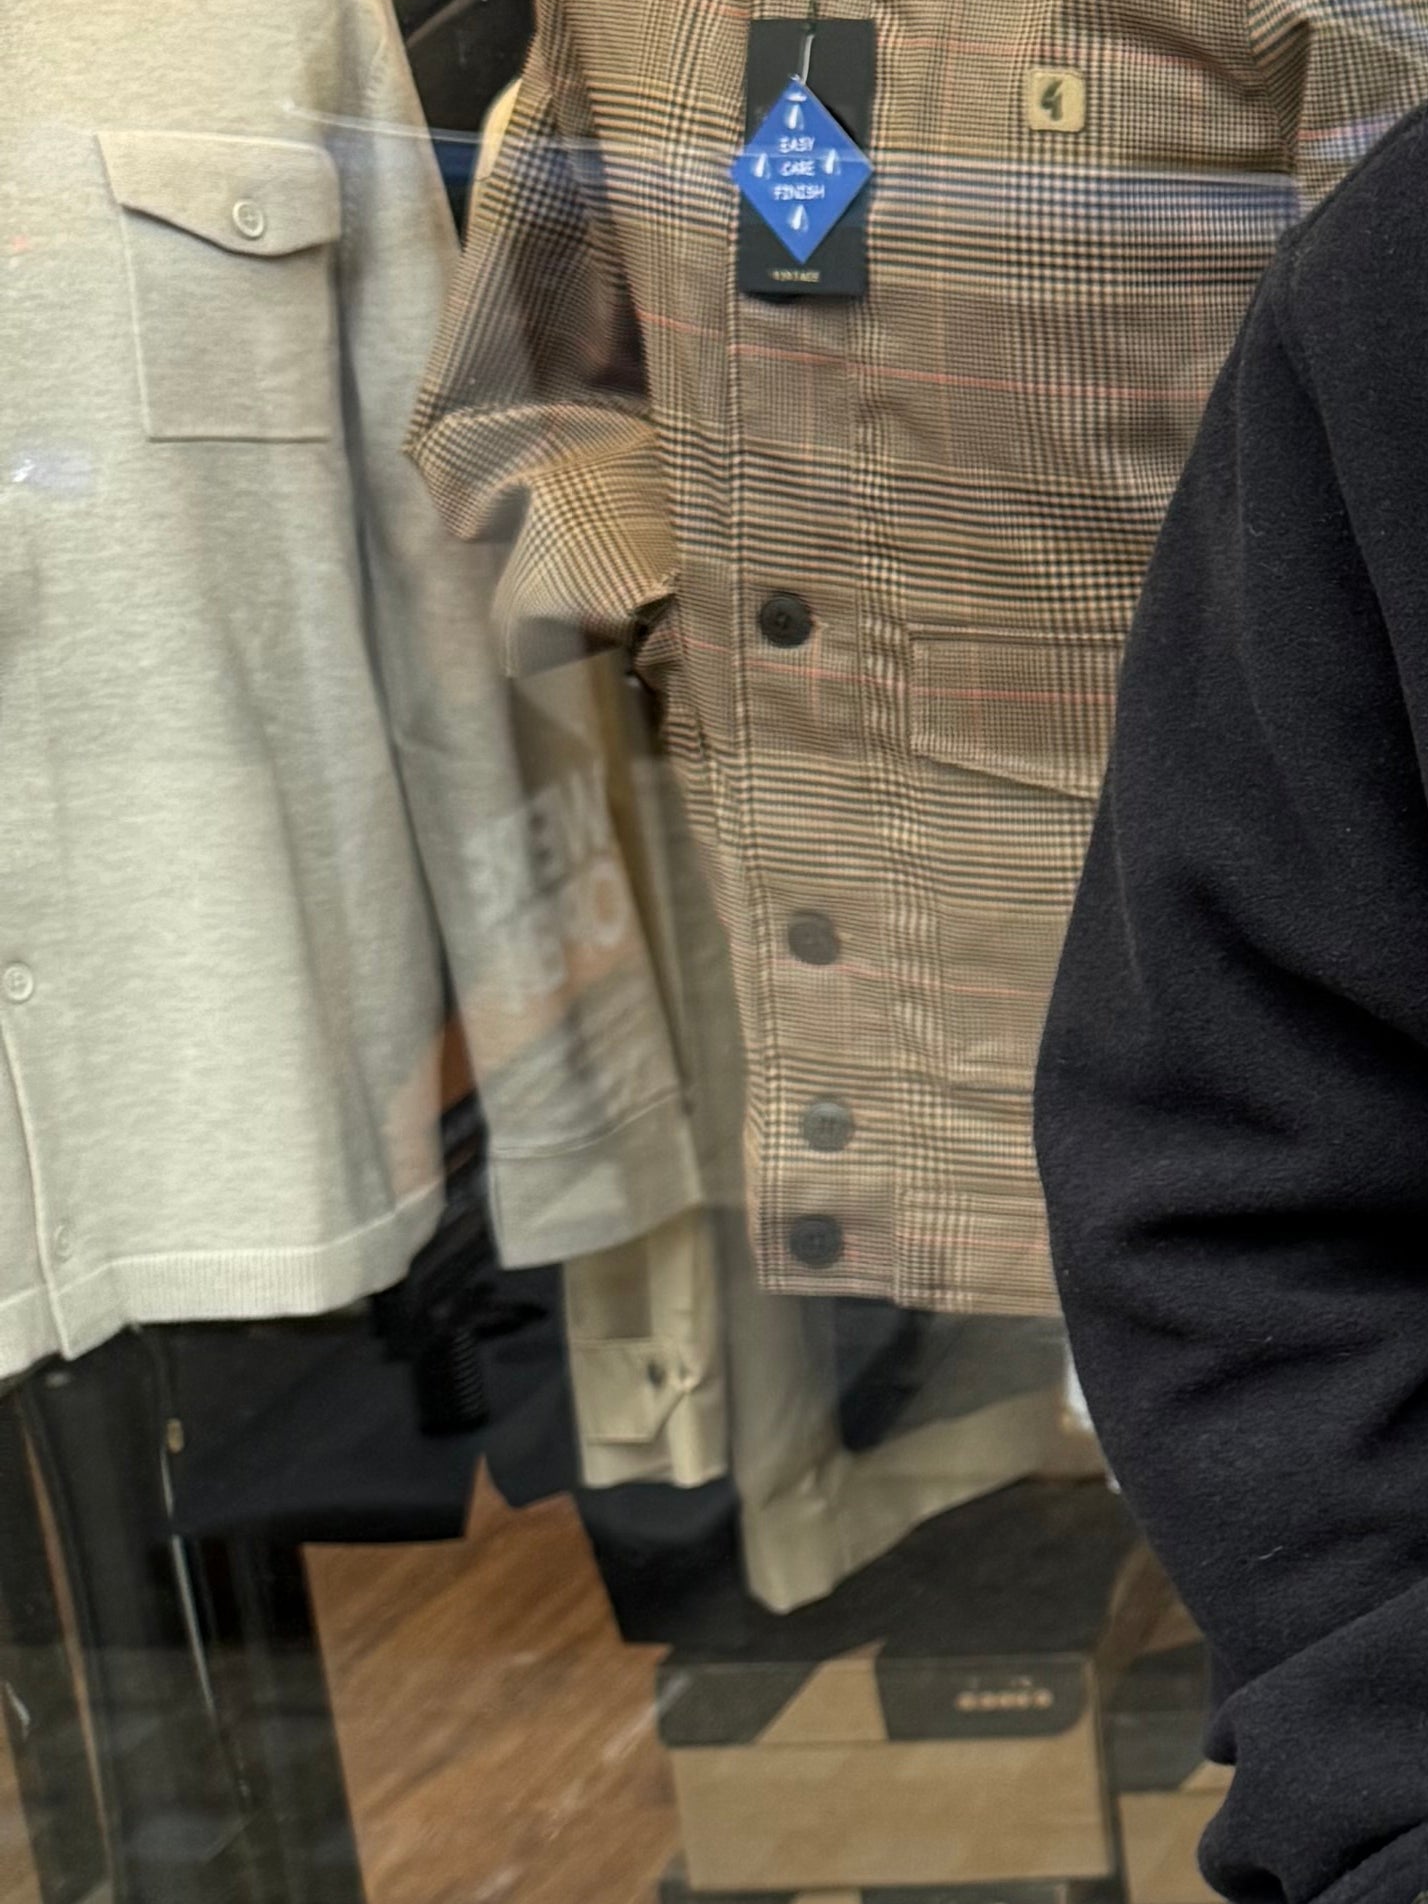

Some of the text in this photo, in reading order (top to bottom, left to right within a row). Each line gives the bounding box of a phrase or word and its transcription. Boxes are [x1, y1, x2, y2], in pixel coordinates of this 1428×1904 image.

[778, 136, 815, 154] EASY
[780, 160, 816, 177] CARE
[773, 184, 826, 202] FINISH
